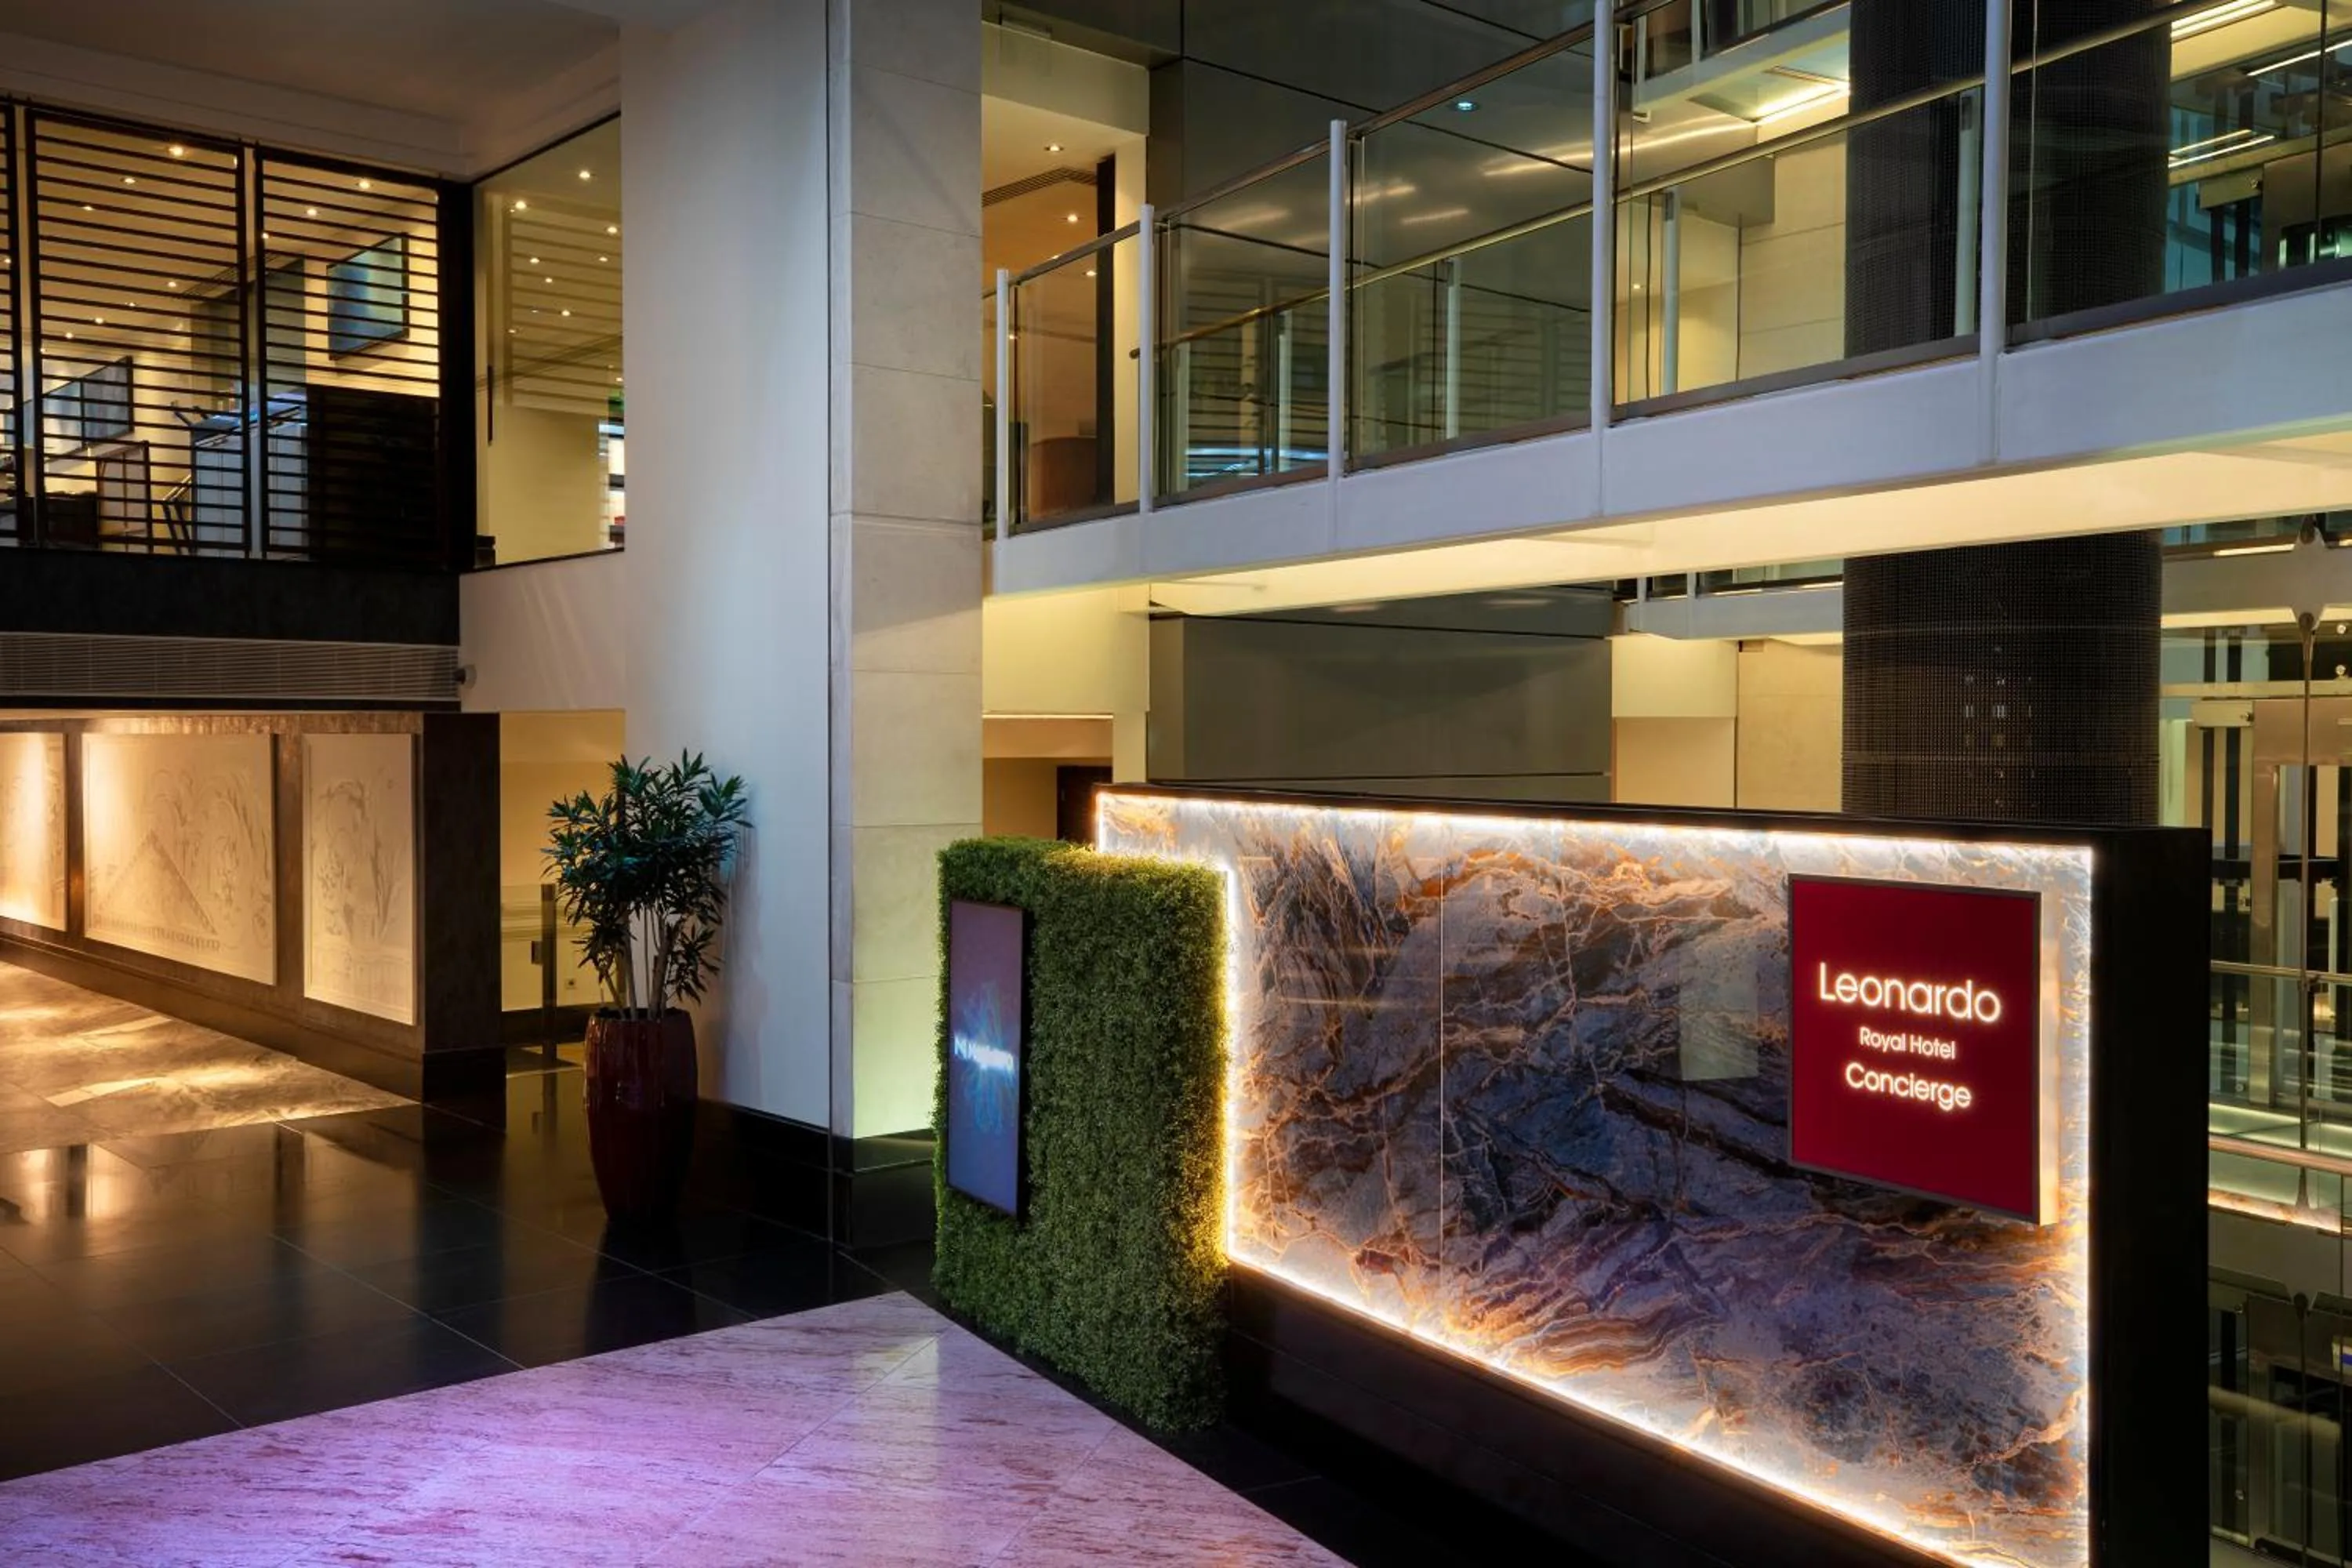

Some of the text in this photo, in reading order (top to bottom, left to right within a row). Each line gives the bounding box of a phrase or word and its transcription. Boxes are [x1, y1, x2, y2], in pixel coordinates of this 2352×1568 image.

[1819, 962, 2002, 1022] Leonardo
[1859, 1026, 1956, 1059] Royal Hotel
[1845, 1062, 1973, 1111] Concierge
